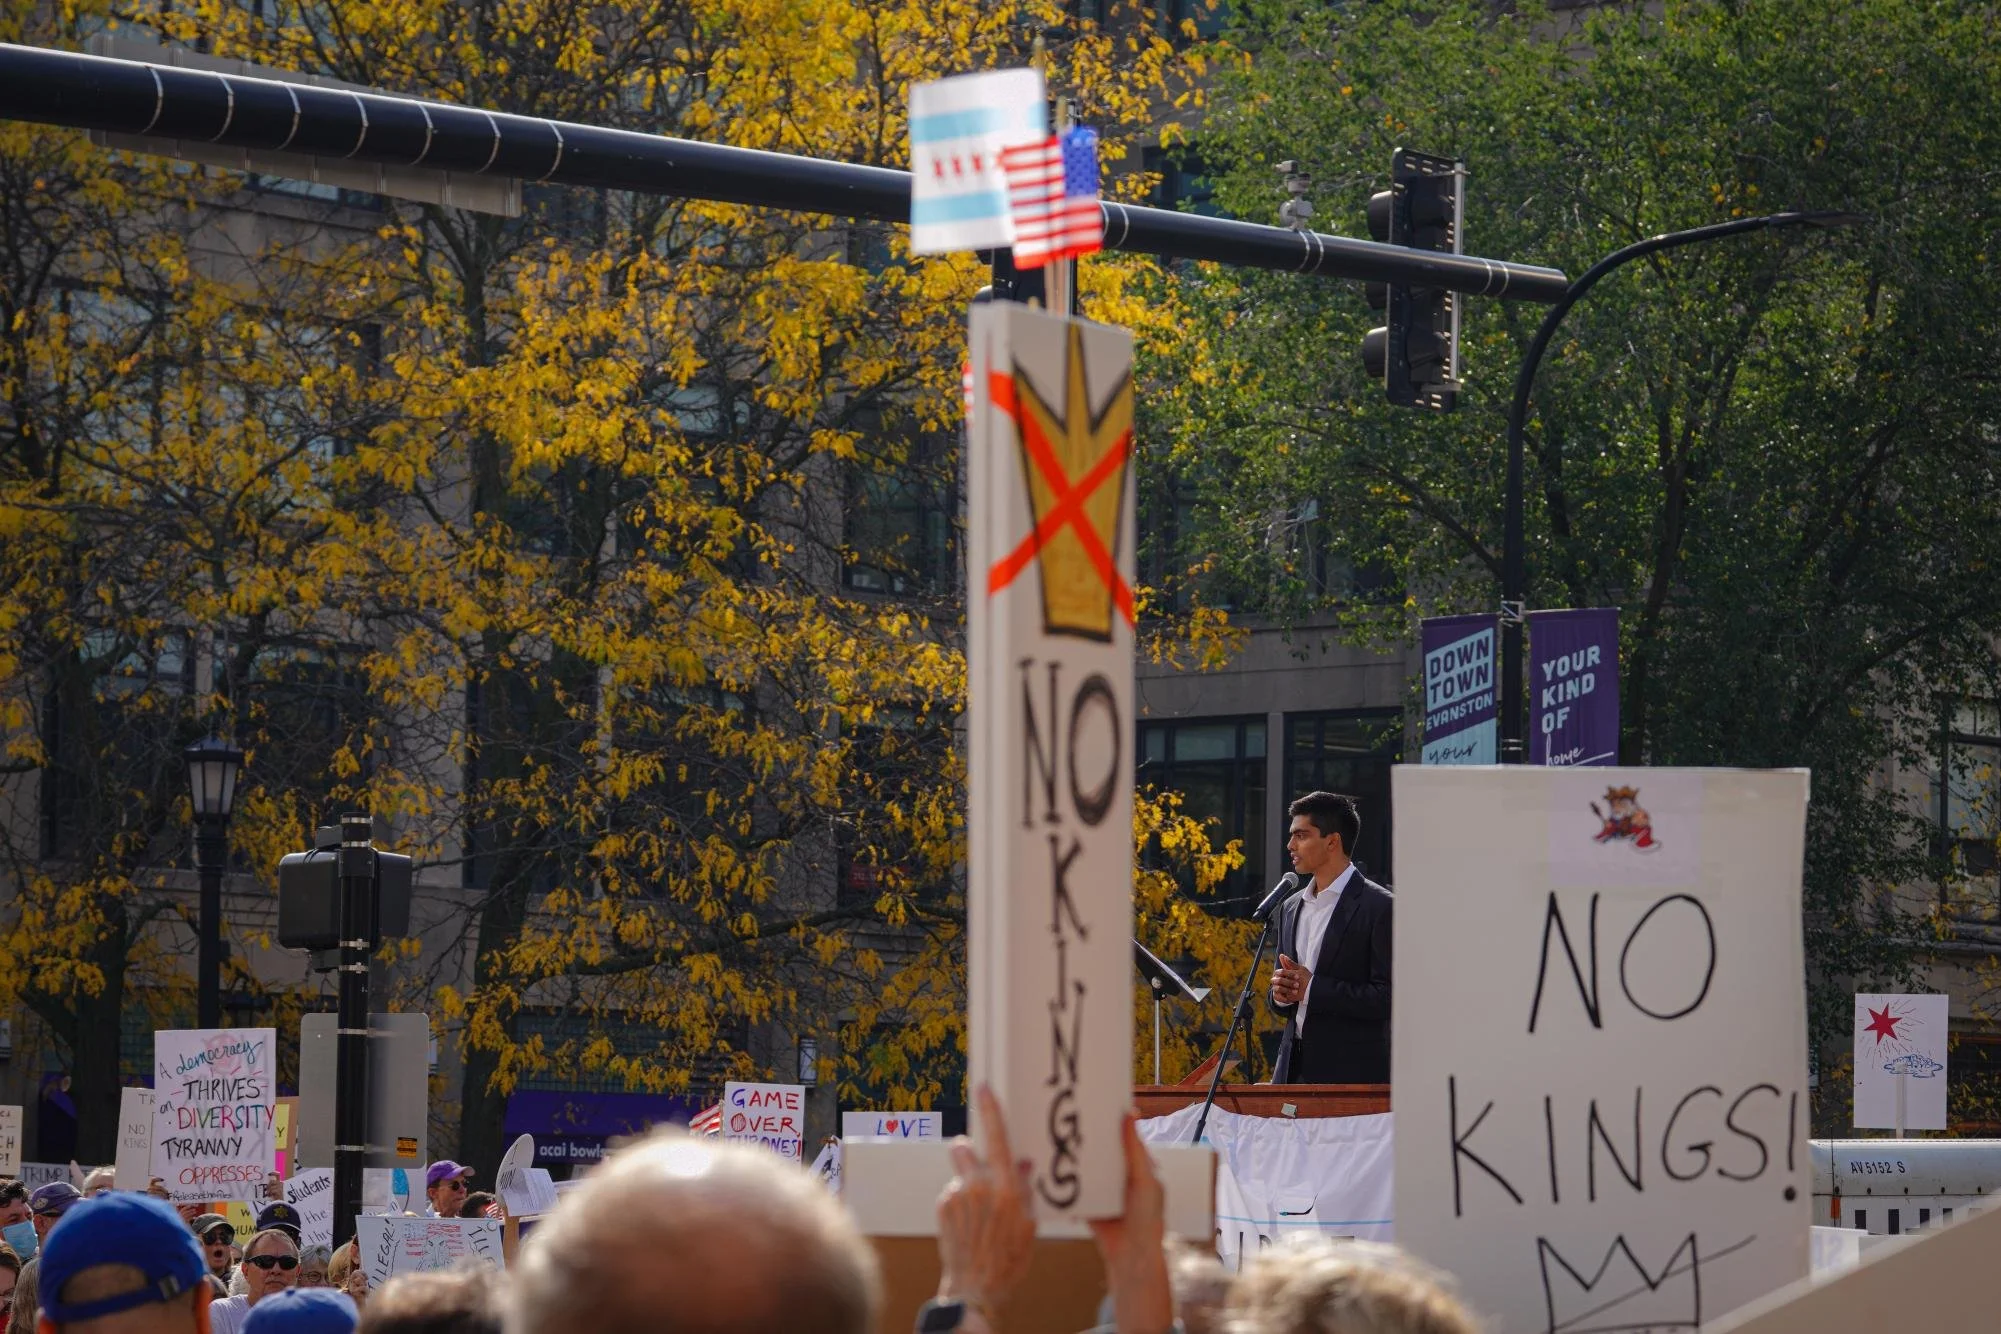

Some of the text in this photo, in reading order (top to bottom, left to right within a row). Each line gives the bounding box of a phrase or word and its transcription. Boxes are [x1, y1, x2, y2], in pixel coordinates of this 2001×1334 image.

[1430, 636, 1489, 679] DOWN
[1542, 645, 1600, 682] YOUR
[1430, 663, 1488, 704] TOWN
[1542, 673, 1595, 709] KIND
[1426, 692, 1493, 732] EVANSTON
[1542, 706, 1570, 734] OF
[1017, 657, 1120, 828] NO
[1528, 891, 1717, 1034] NO
[1037, 832, 1089, 1211] KINGS
[159, 1041, 263, 1080] A democracy
[182, 1077, 260, 1102] THRIVES
[731, 1088, 799, 1109] GAME
[128, 1123, 146, 1135] NO
[160, 1101, 175, 1114] on
[177, 1104, 275, 1133] DIVERSITY
[160, 1136, 242, 1160] TYRANNY
[539, 1142, 566, 1157] acai
[1448, 1074, 1798, 1218] KINGS!
[21, 1166, 63, 1182] TRUMP
[179, 1165, 264, 1185] OPPRESSES
